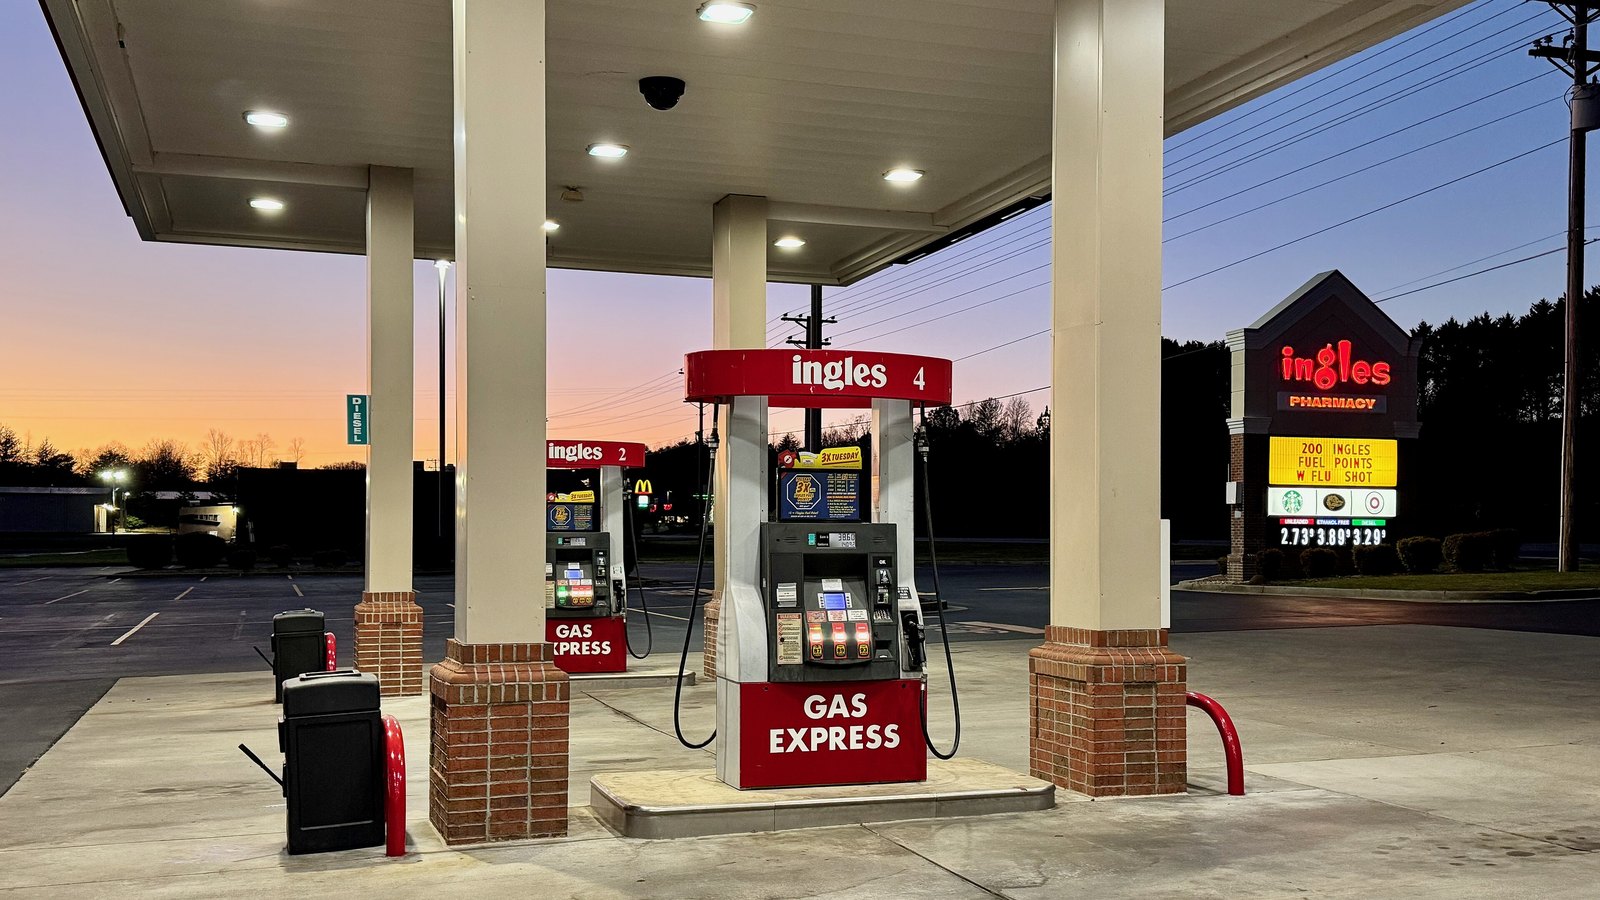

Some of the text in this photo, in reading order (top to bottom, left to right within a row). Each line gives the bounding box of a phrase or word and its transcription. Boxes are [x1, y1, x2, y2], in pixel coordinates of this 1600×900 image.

[1281, 339, 1391, 390] ingles
[792, 354, 926, 391] ingles 4
[1289, 395, 1376, 410] PHARMACY
[352, 397, 362, 442] DIESEL
[548, 442, 627, 462] ingles 2
[821, 452, 832, 463] 3X
[832, 450, 860, 461] TUESDAY
[1301, 443, 1371, 456] 200 INGLES
[1298, 456, 1373, 469] FUEL POINTS
[1297, 470, 1373, 483] W FLU SHOT
[577, 491, 593, 499] TUESDAY
[1316, 518, 1337, 526] ETHANOL
[556, 624, 593, 638] GAS
[553, 641, 612, 656] PRESS
[803, 693, 868, 720] GAS
[769, 724, 901, 754] EXPRESS
